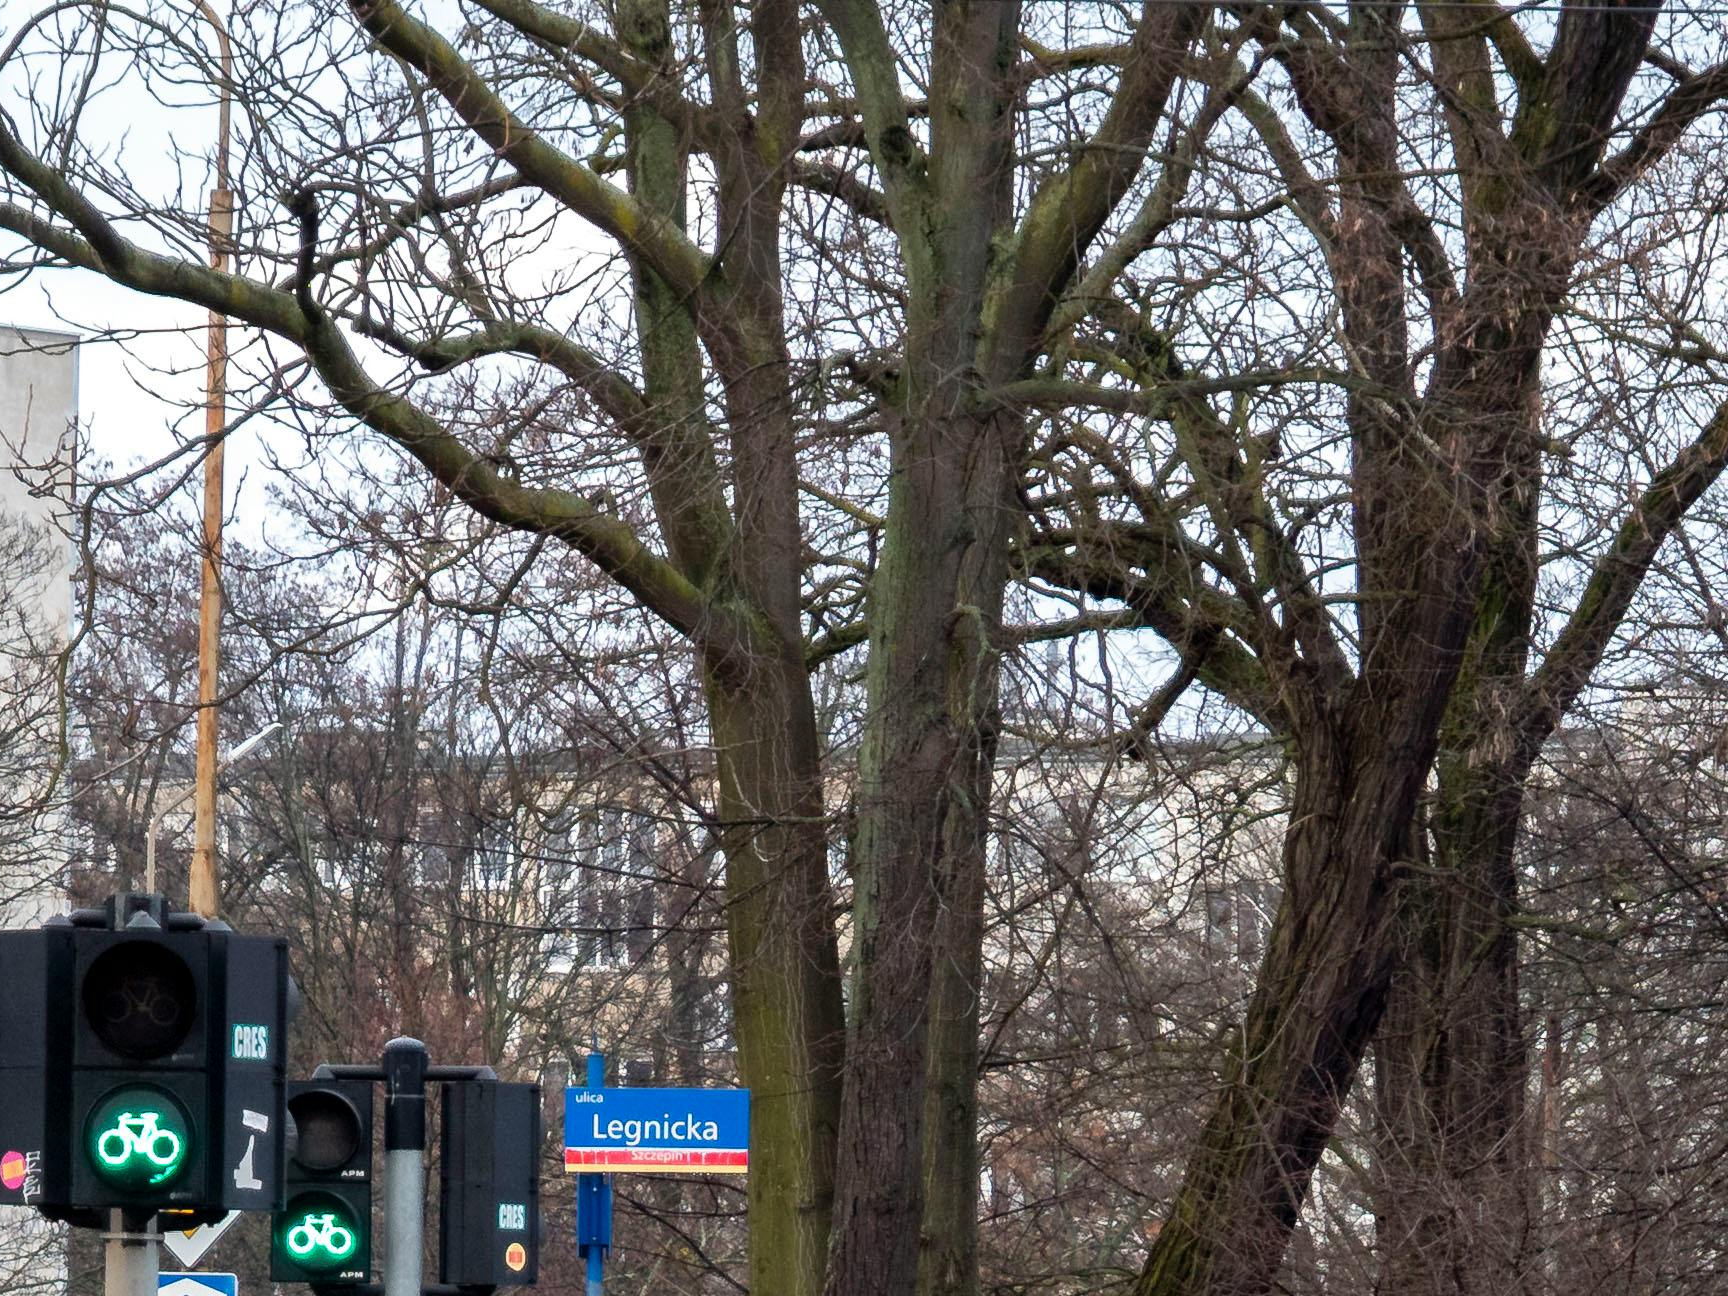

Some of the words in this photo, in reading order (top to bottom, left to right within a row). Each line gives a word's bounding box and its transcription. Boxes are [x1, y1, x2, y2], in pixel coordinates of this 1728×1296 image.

[234, 1025, 267, 1059] CRES
[575, 1091, 604, 1103] ulica
[592, 1113, 719, 1146] Legnicka
[630, 1151, 684, 1163] Szczepin
